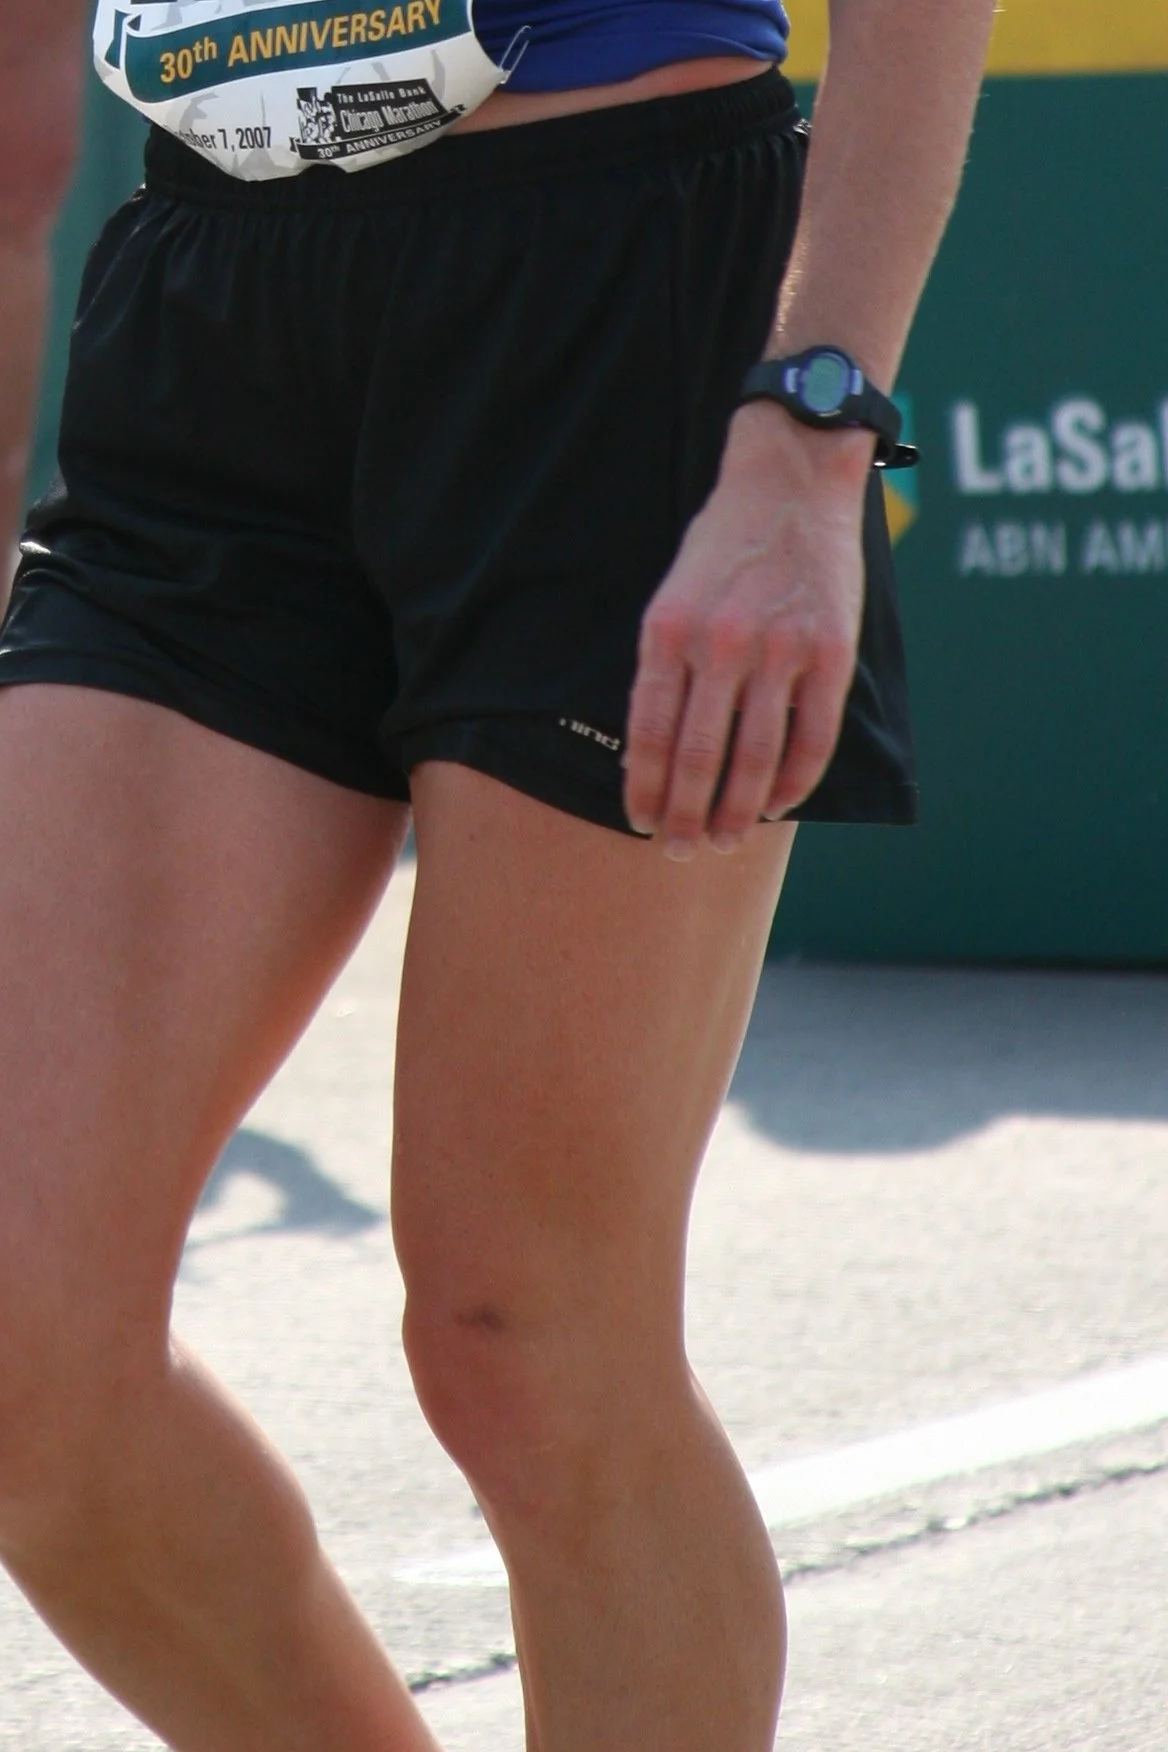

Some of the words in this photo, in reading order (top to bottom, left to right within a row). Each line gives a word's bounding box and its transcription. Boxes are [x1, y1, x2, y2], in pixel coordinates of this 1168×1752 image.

[159, 36, 218, 84] 30th
[337, 93, 354, 105] The
[358, 90, 395, 103] LaSalle
[399, 86, 427, 98] Bank
[339, 108, 385, 133] Chicago
[382, 100, 440, 126] Marathon
[217, 128, 235, 152] 7,
[235, 126, 272, 150] 2007
[346, 119, 443, 154] ANNIVERSARY
[959, 520, 1068, 576] ABN
